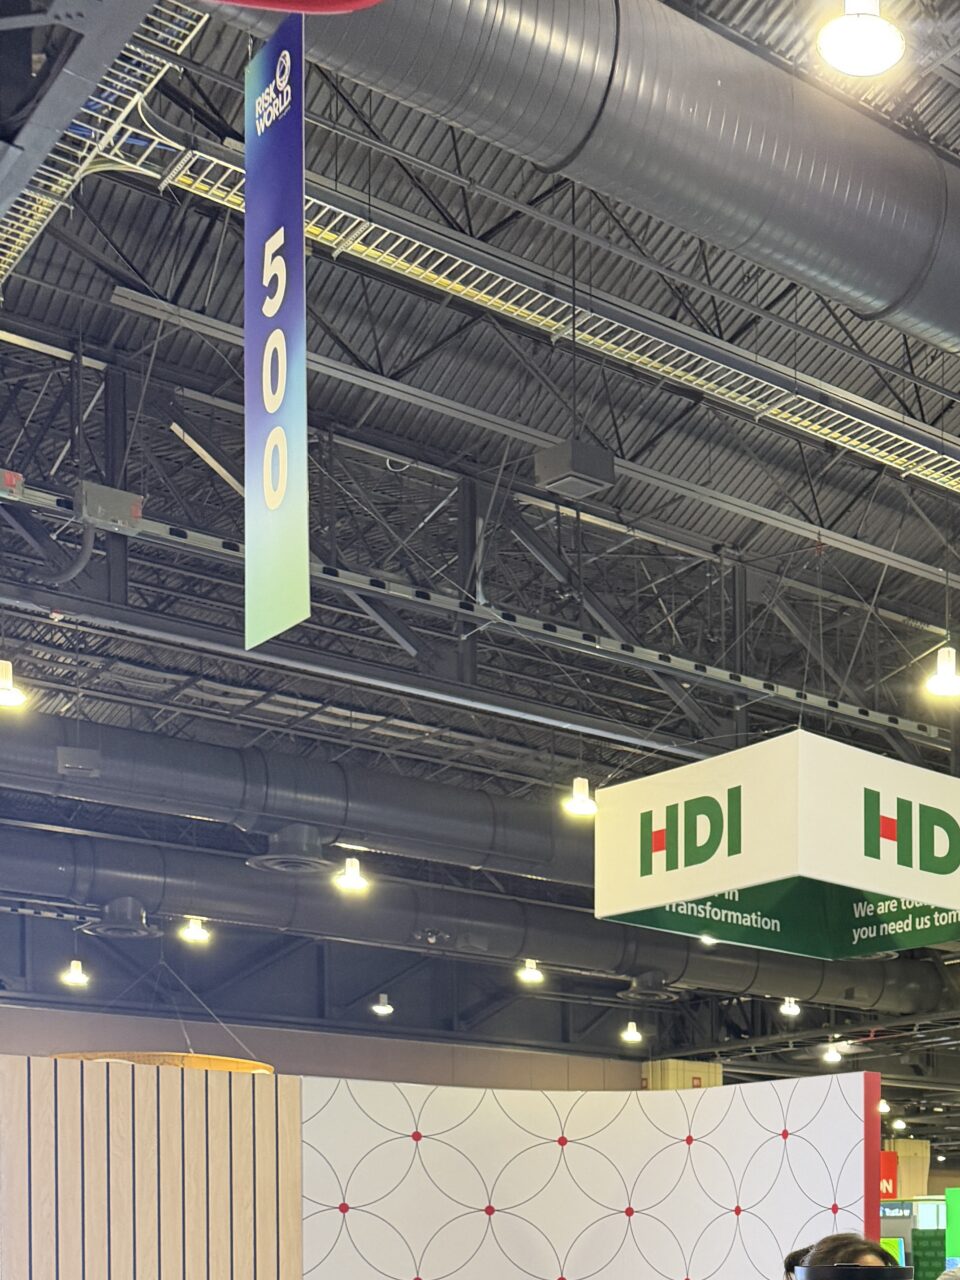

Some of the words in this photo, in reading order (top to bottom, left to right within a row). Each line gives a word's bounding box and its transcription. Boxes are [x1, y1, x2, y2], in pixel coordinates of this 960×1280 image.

[255, 80, 276, 118] RISK
[255, 85, 291, 136] WORLD
[261, 226, 287, 511] 500
[640, 784, 742, 877] HDI
[852, 925, 877, 944] you
[879, 914, 912, 936] need
[915, 914, 931, 929] us
[853, 900, 875, 919] We
[876, 898, 898, 915] are
